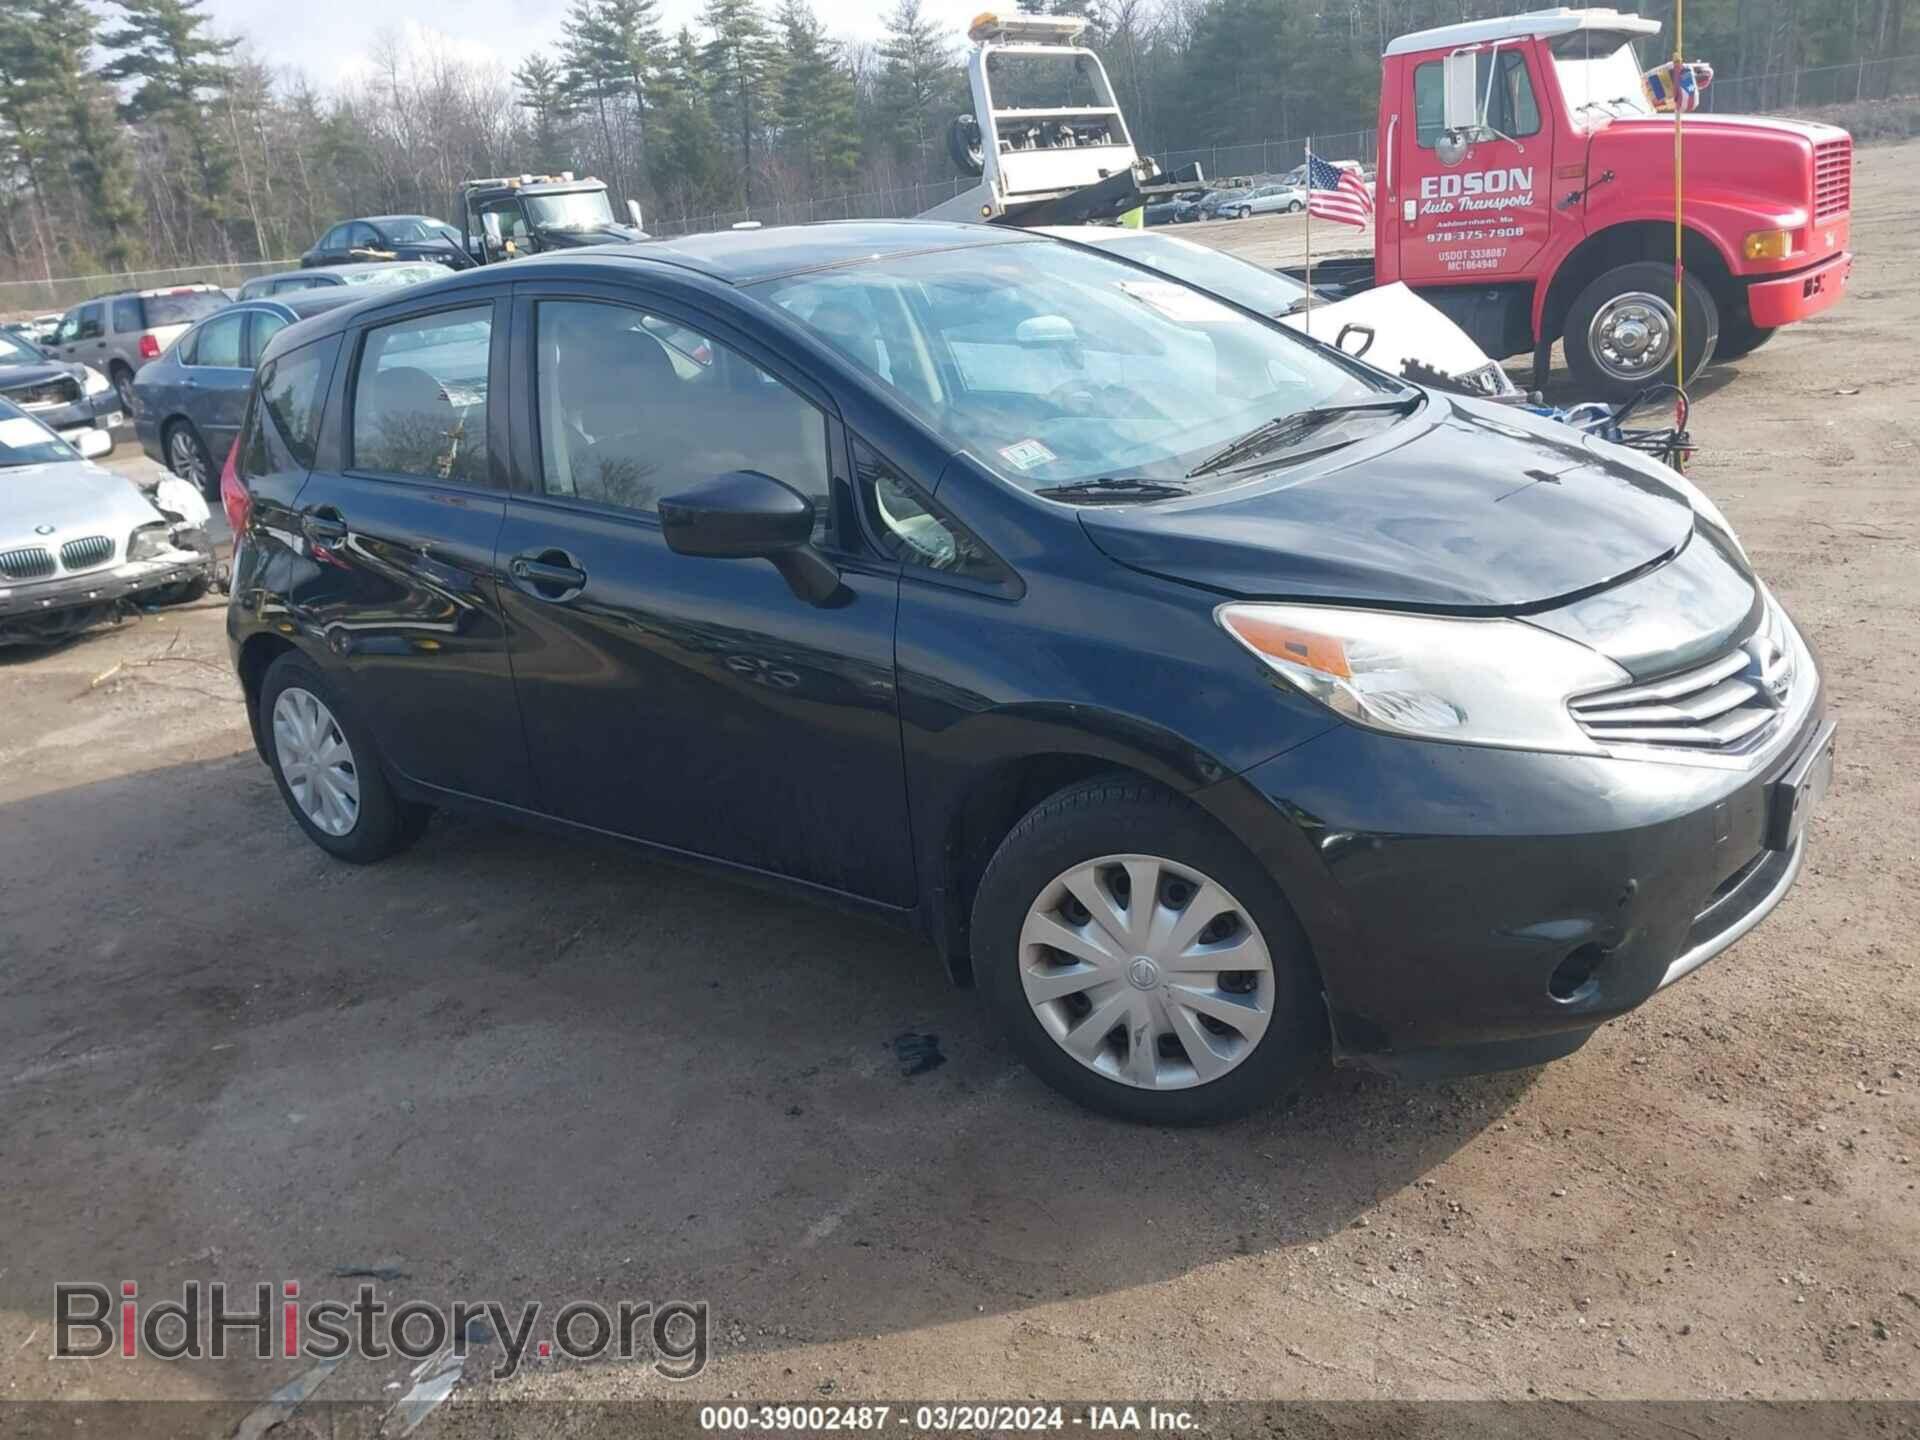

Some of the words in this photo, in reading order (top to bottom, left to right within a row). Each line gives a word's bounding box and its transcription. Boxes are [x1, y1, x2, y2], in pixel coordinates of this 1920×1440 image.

[1420, 167, 1533, 199] EDSON
[1420, 199, 1454, 215] Auto
[1458, 191, 1533, 212] Transport
[1427, 227, 1524, 242] 978-375-7908
[1438, 249, 1467, 262] USDOT
